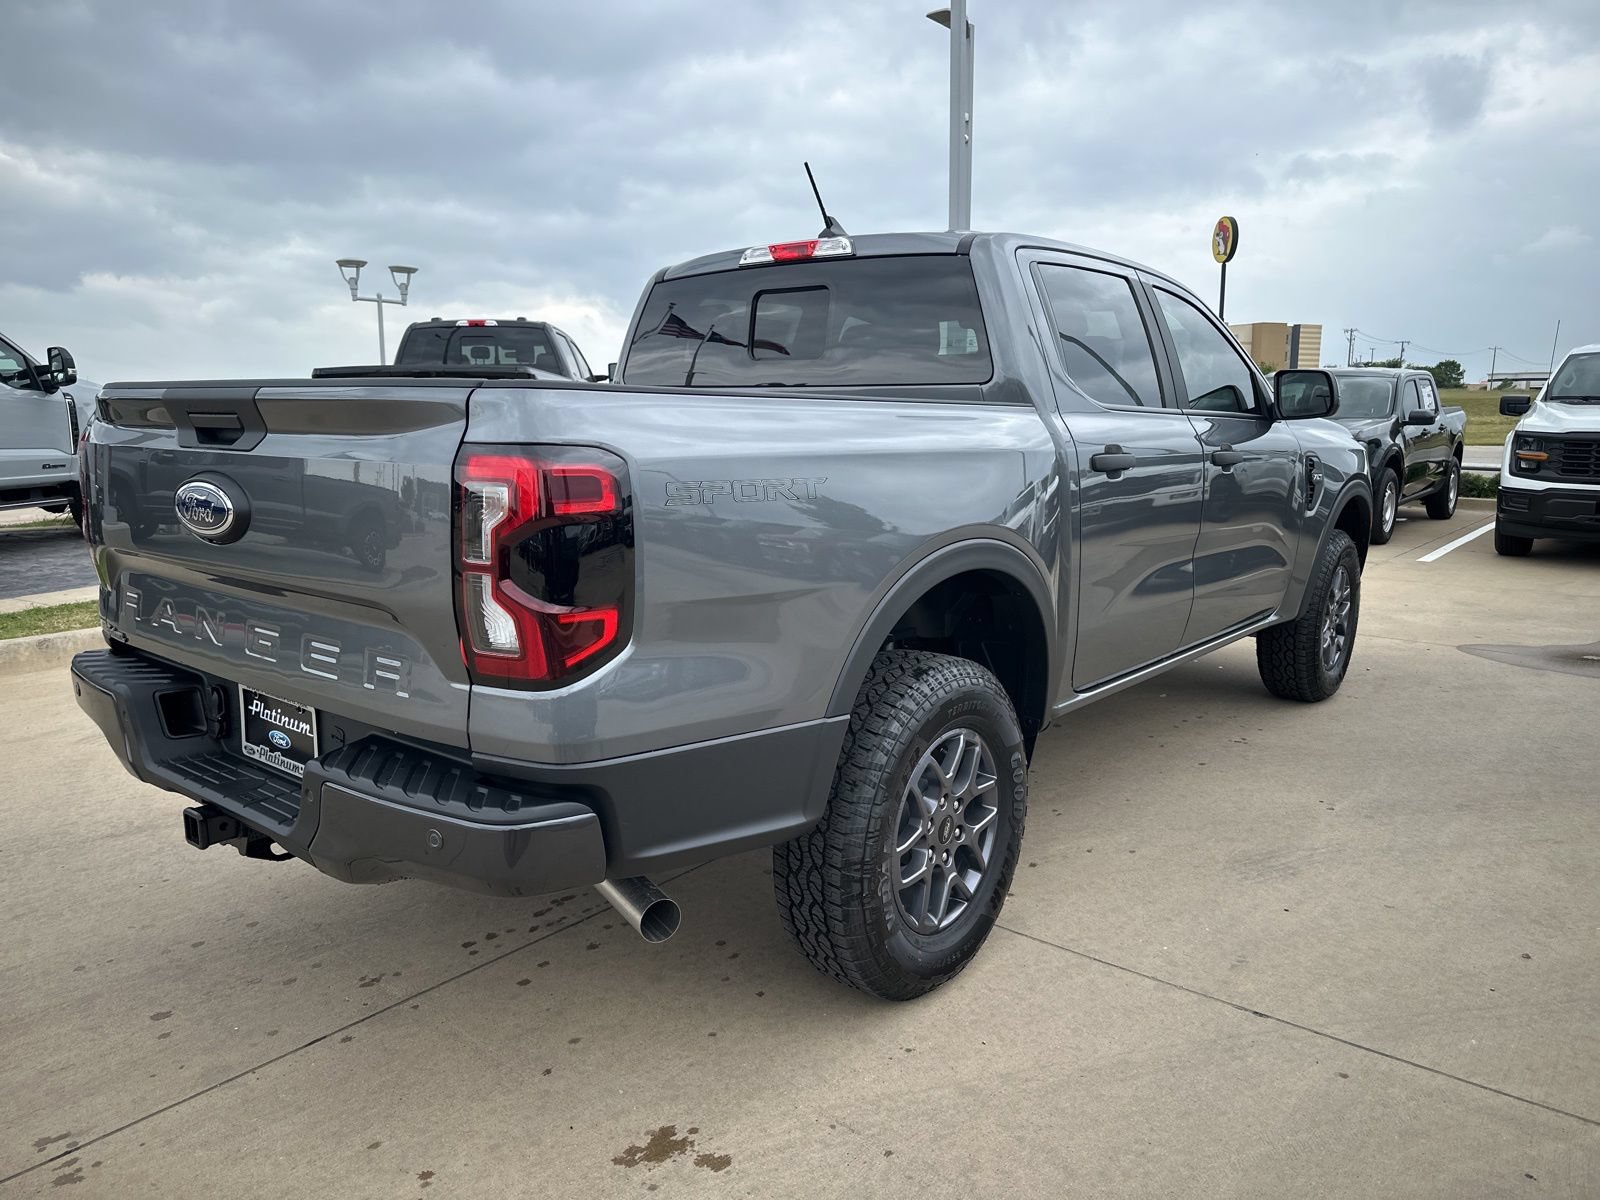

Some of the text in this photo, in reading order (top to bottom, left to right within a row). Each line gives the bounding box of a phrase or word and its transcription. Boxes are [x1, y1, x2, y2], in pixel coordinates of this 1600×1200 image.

[665, 477, 828, 506] SPORT
[184, 492, 215, 523] Ford
[119, 584, 412, 699] RANGER
[248, 699, 314, 737] Platinum
[273, 733, 287, 747] Ford
[260, 747, 301, 774] Platinum
